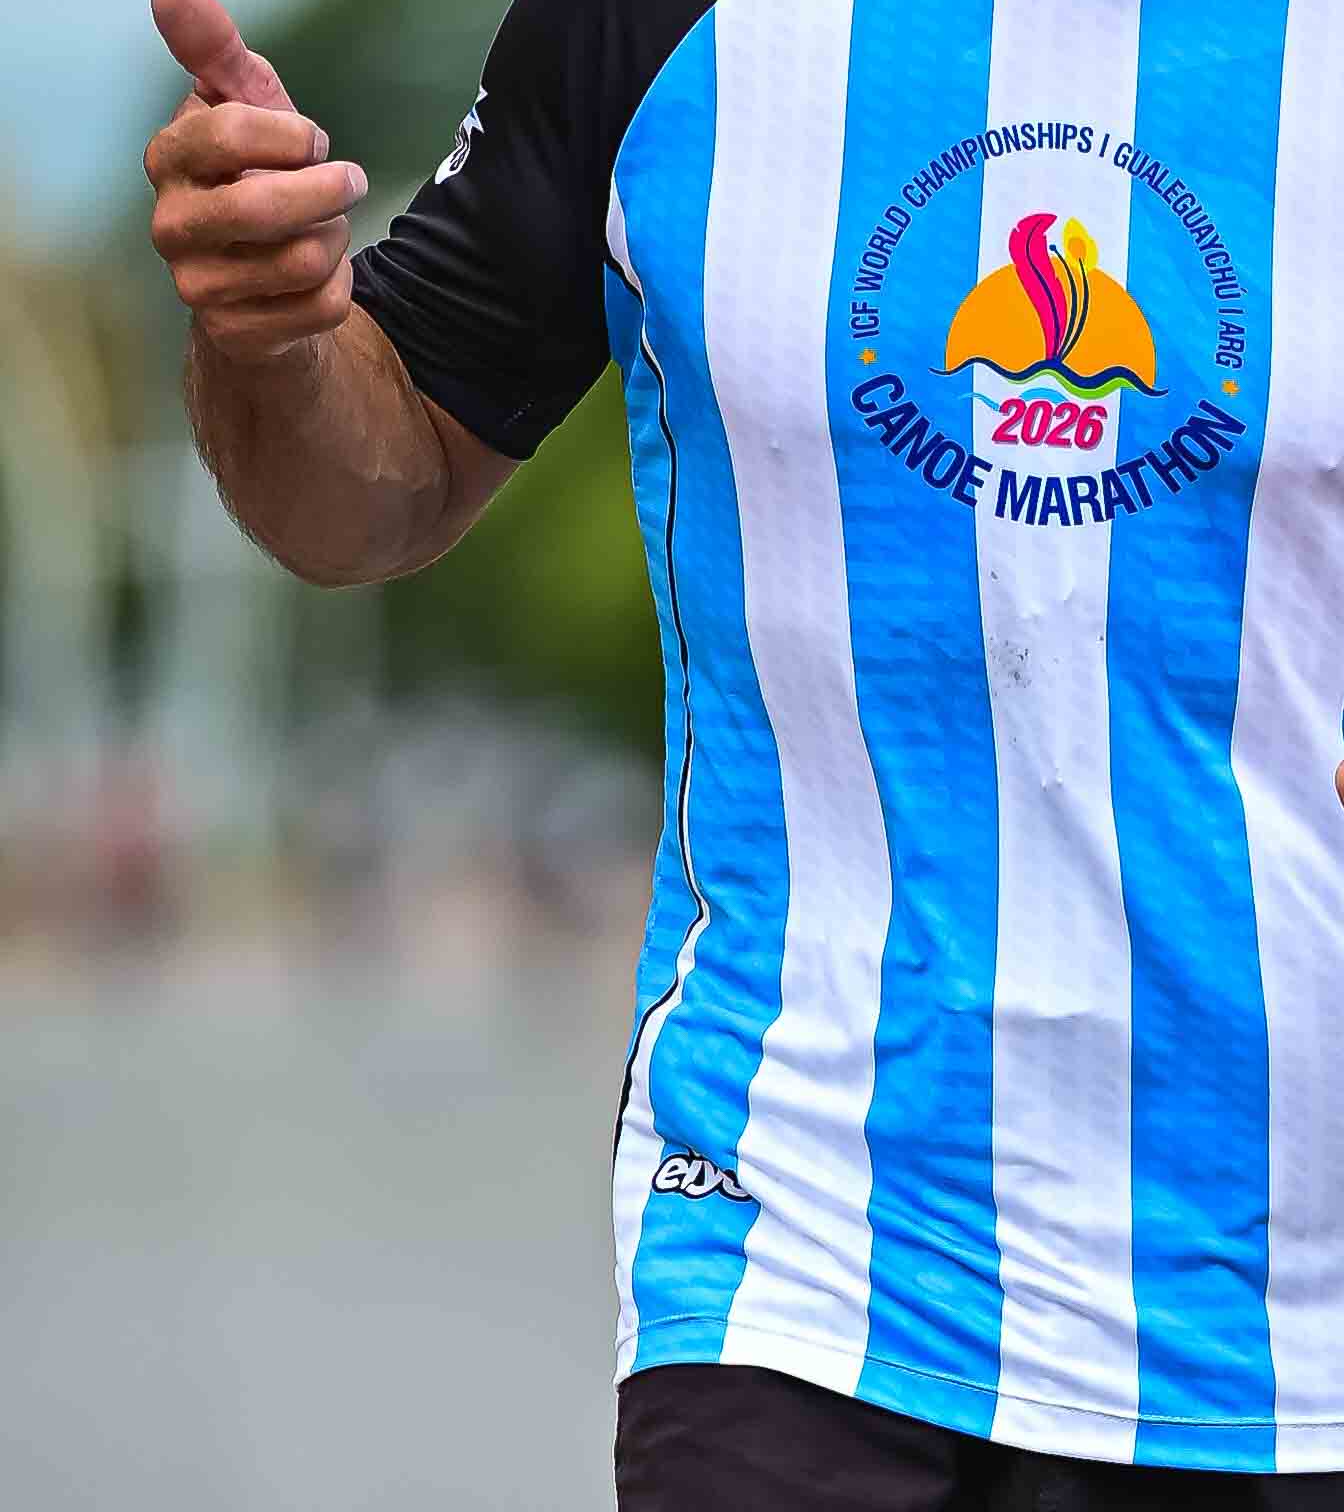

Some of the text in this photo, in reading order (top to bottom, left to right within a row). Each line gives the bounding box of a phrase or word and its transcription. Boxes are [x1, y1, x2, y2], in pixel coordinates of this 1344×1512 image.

[901, 122, 1095, 209] CHAMPIONSHIPS
[854, 204, 913, 294] WORLD
[1112, 141, 1248, 301] GUALEGUAYCHÚ
[850, 300, 881, 340] ICF
[1214, 317, 1246, 370] ARG
[850, 372, 1247, 527] CANOE MARATHON
[991, 398, 1108, 451] 2026
